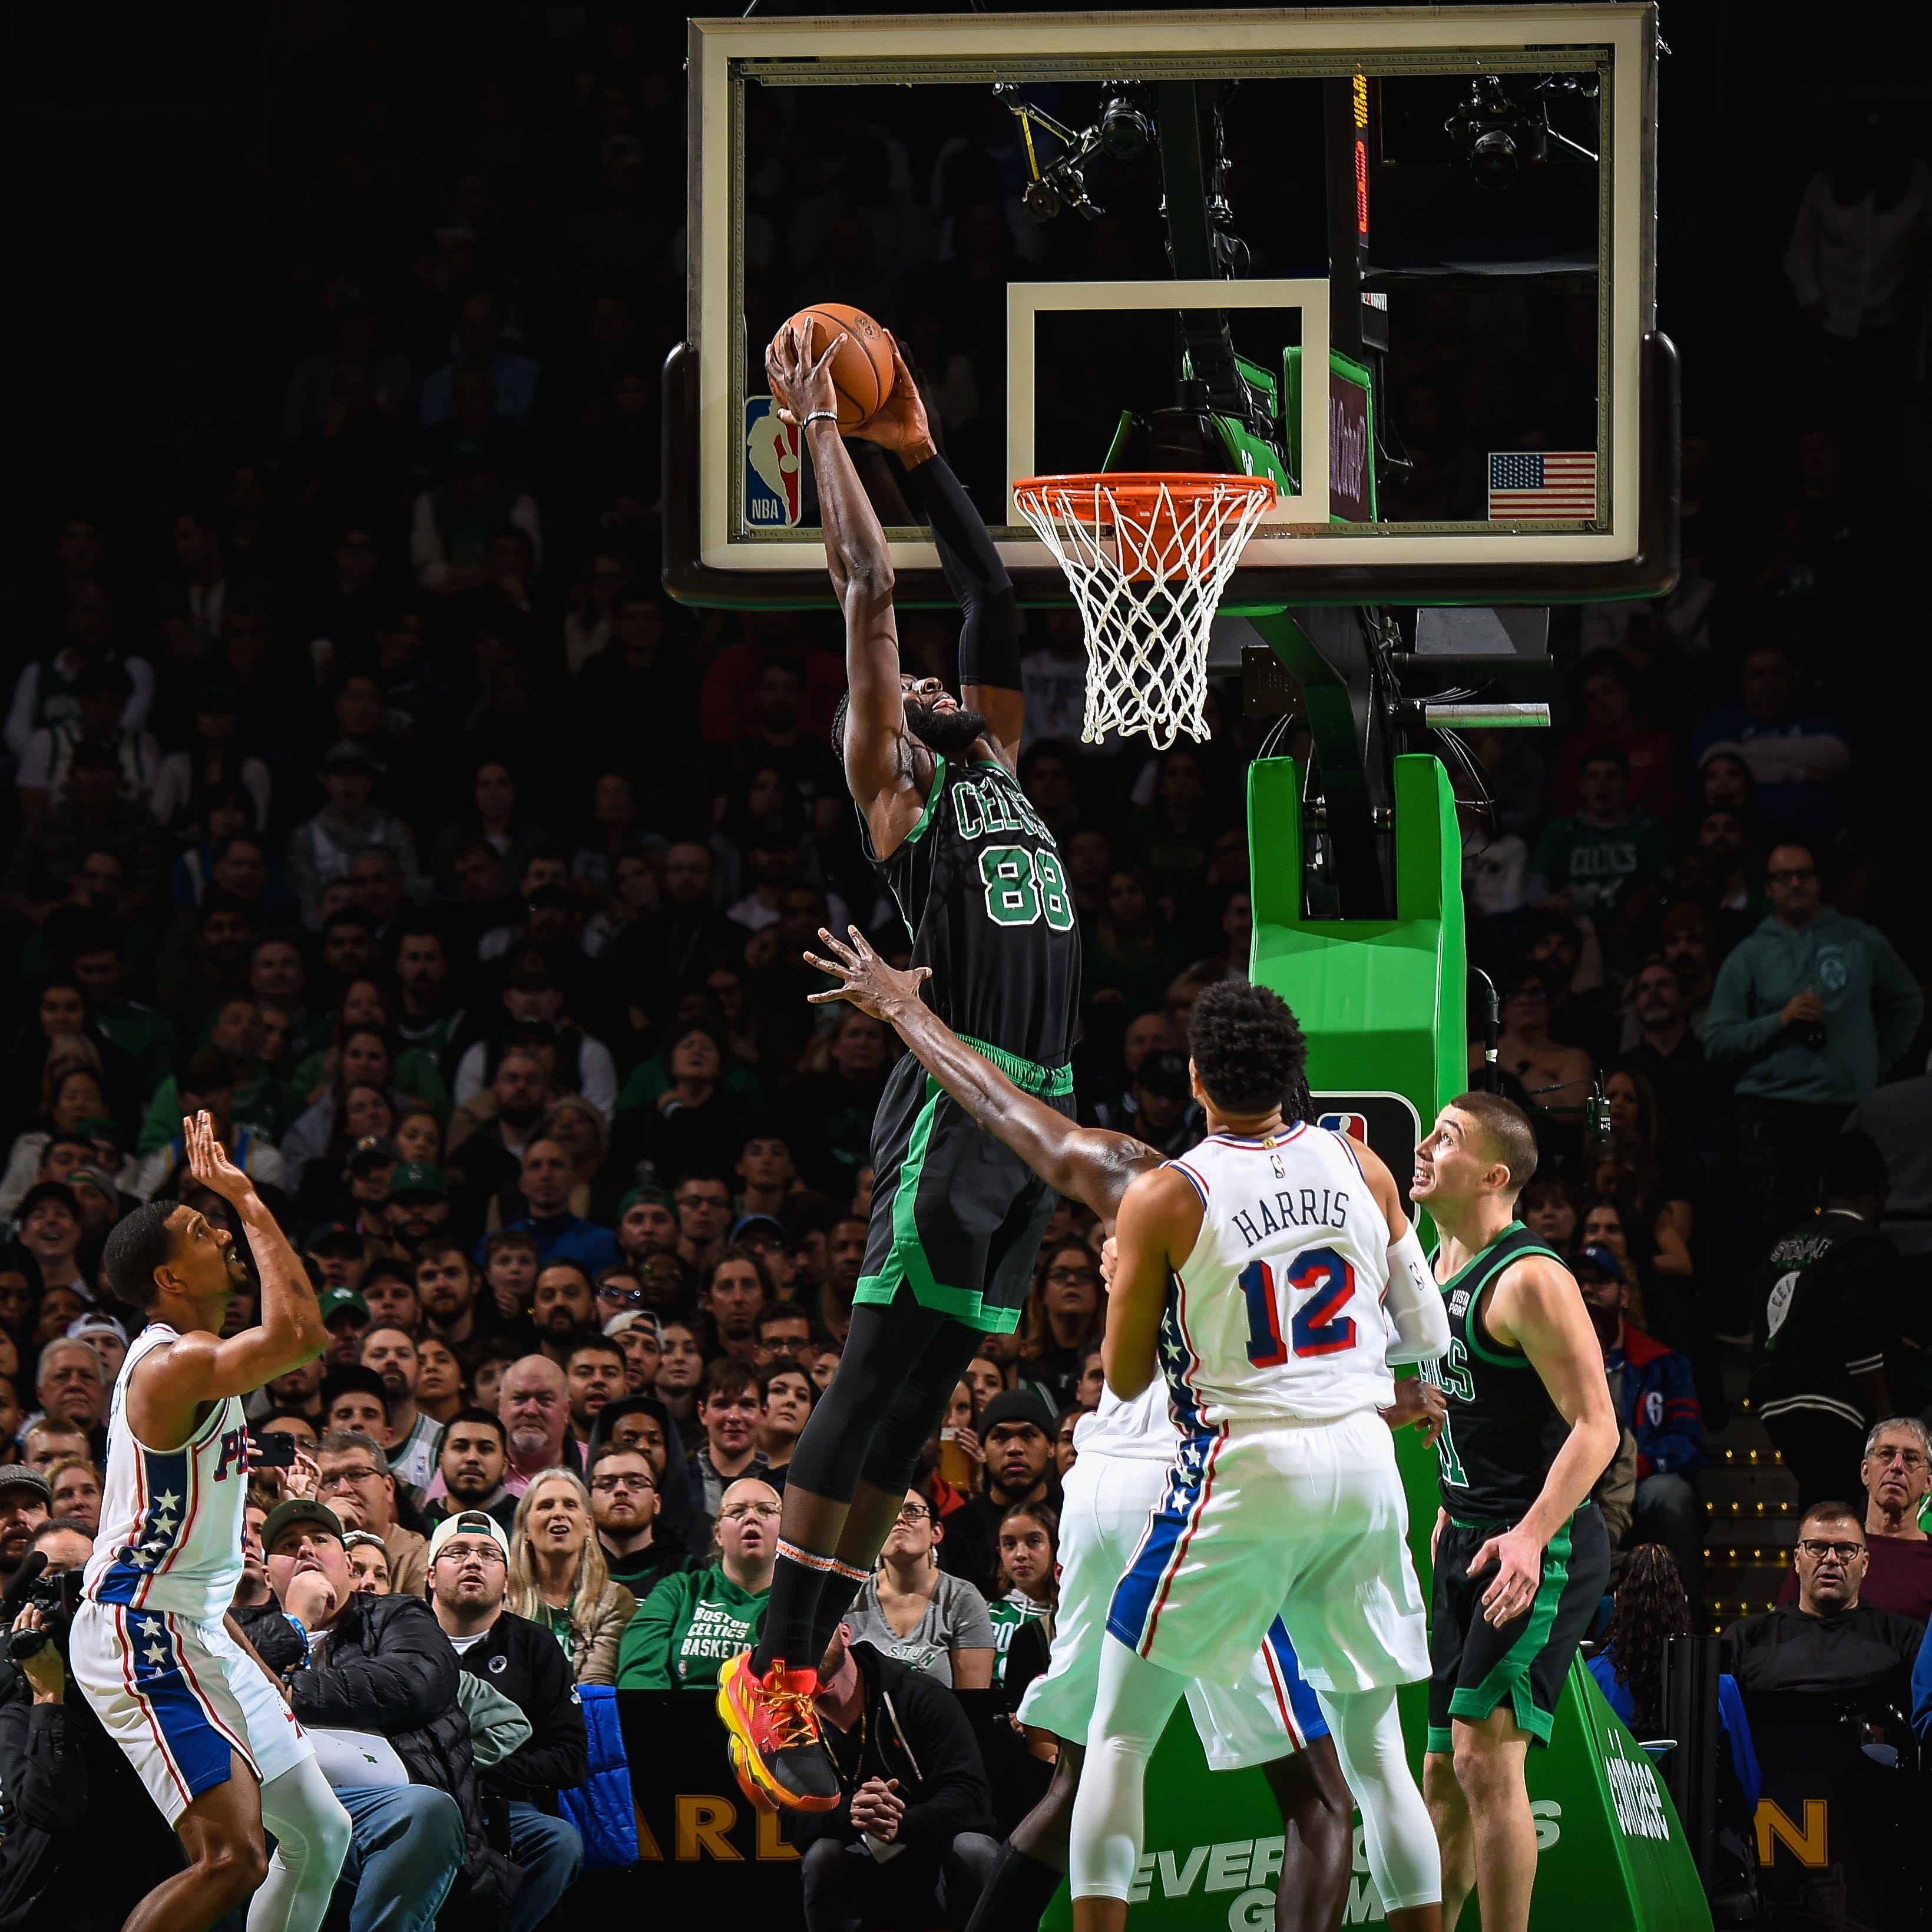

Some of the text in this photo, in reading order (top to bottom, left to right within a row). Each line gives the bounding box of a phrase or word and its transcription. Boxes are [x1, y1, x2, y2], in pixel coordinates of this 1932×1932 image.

[752, 499, 779, 519] NBA
[978, 844, 1075, 932] 88
[1232, 1189, 1349, 1248] HARRIS
[1238, 1246, 1357, 1369] 12
[687, 1623, 747, 1639] CELTICS
[693, 1607, 750, 1629] BOSTON
[1605, 1727, 1670, 1842] coinbase
